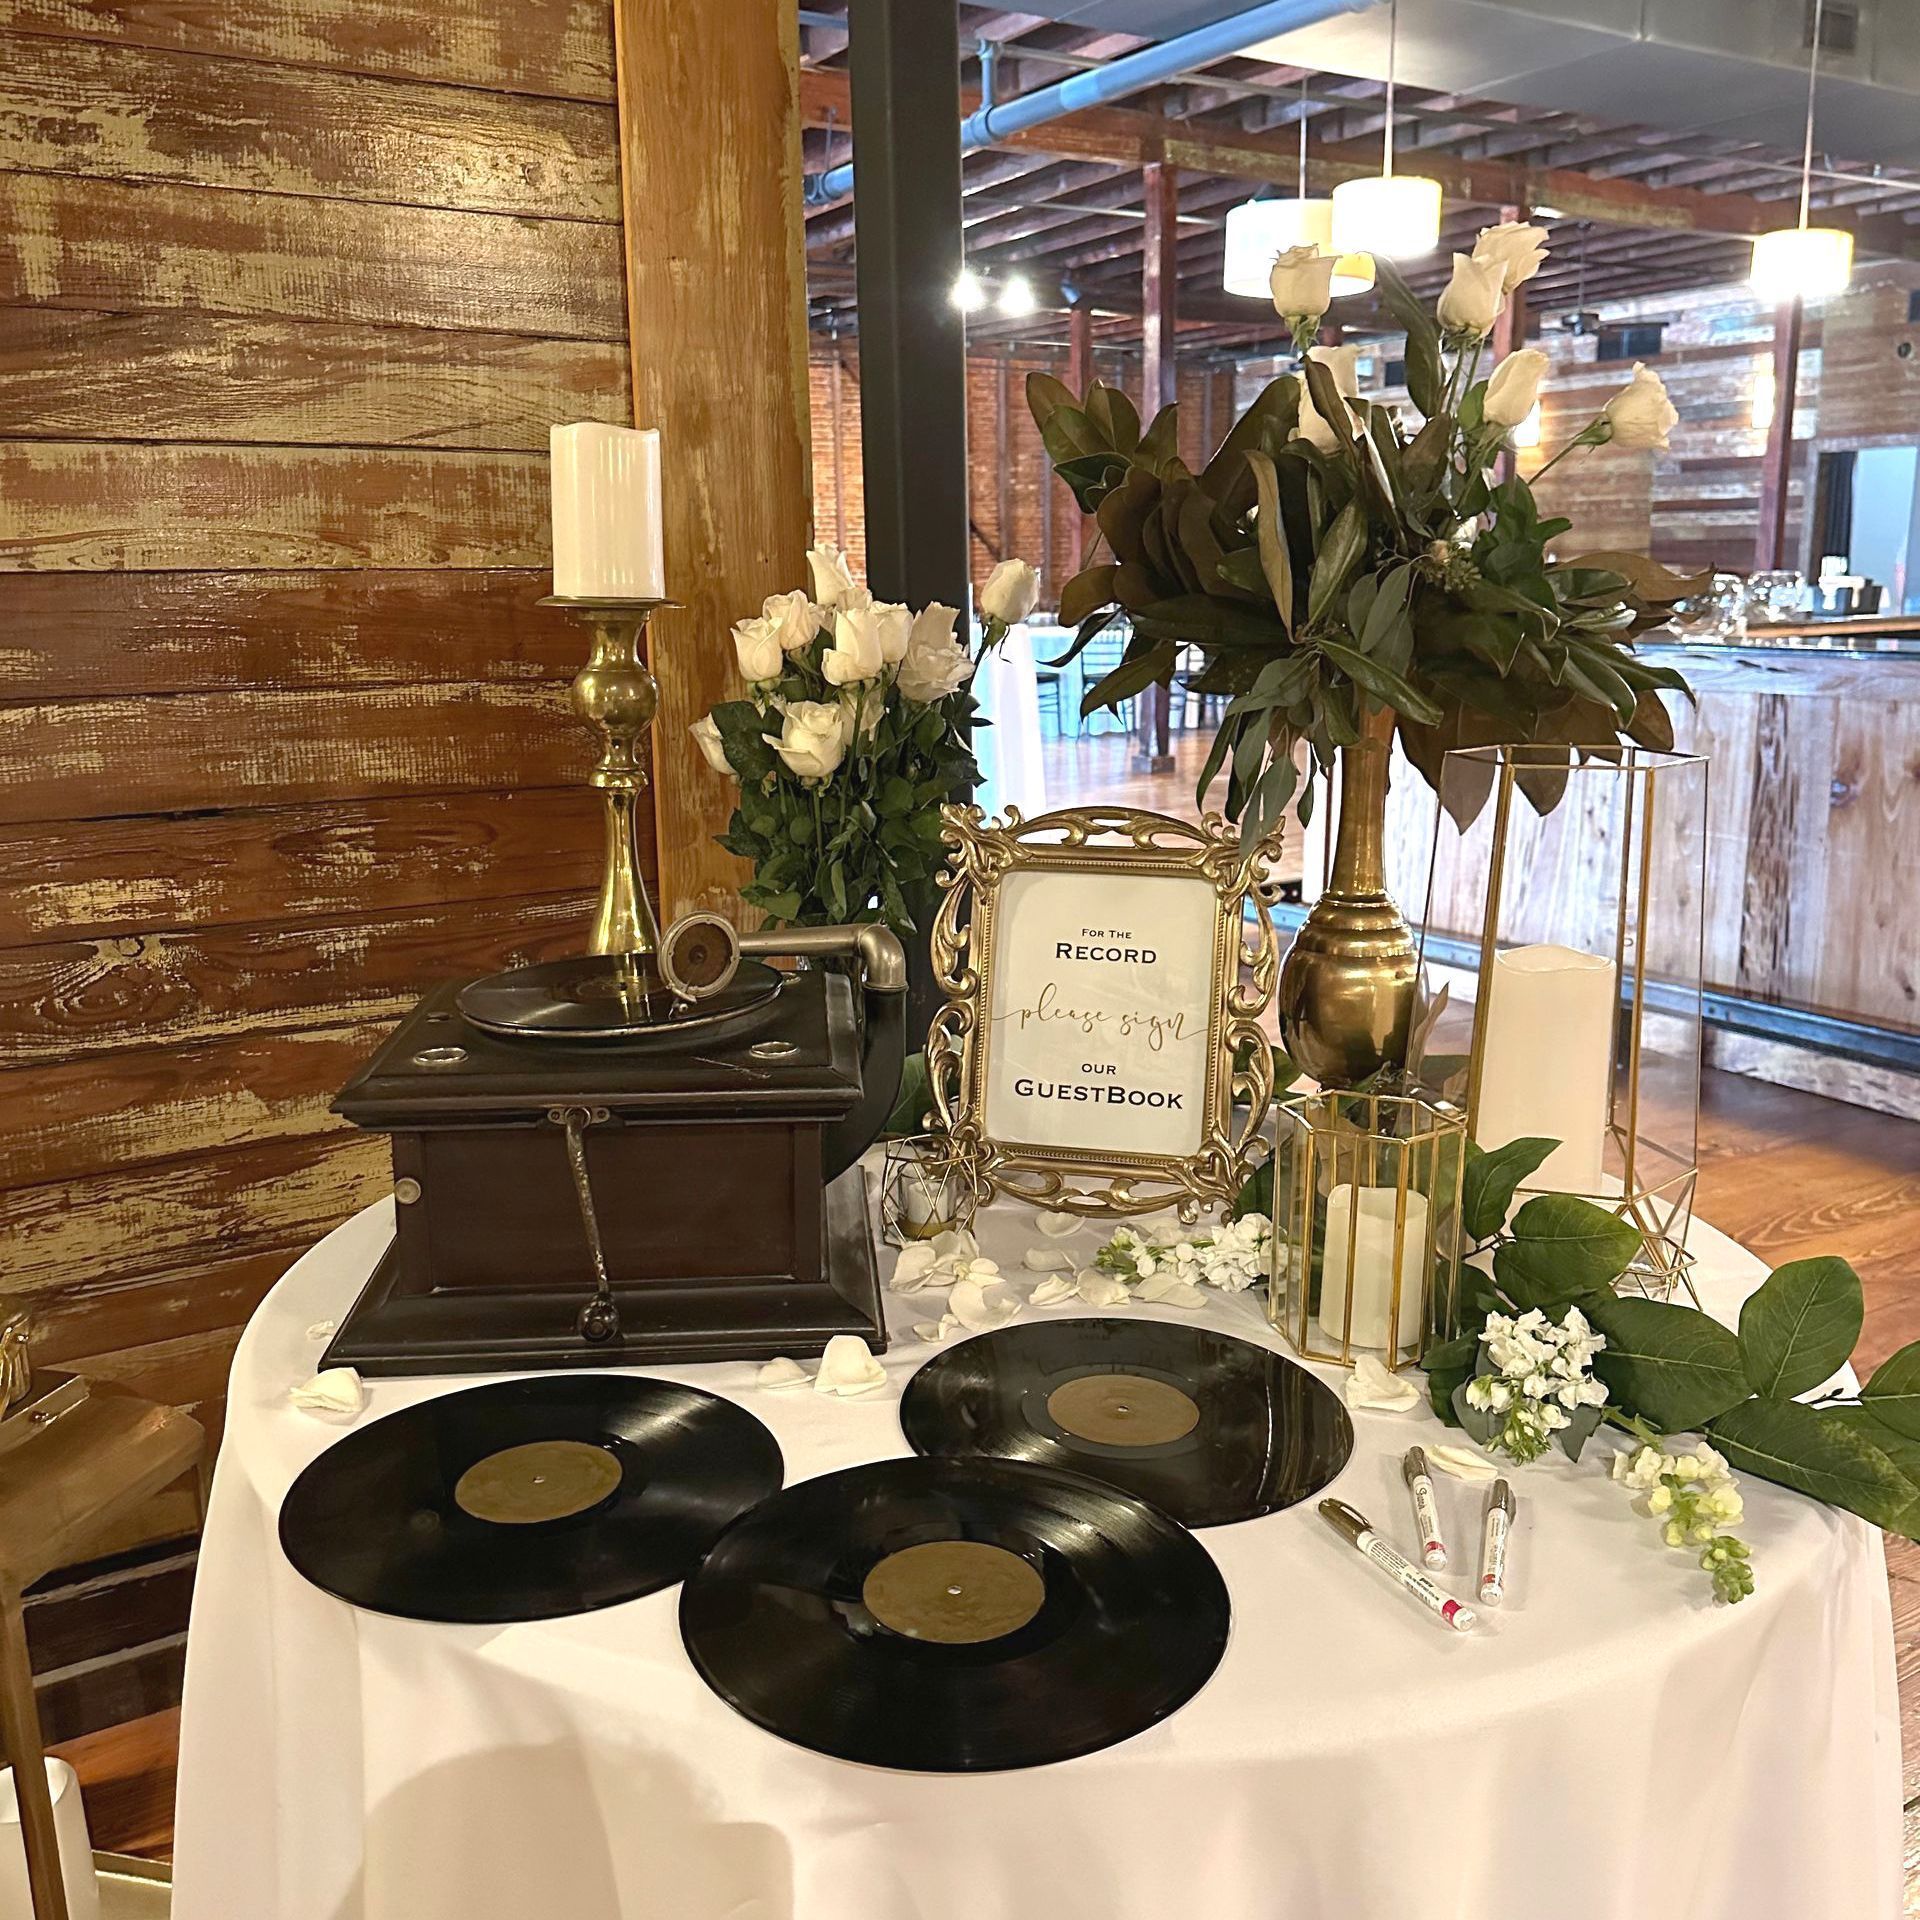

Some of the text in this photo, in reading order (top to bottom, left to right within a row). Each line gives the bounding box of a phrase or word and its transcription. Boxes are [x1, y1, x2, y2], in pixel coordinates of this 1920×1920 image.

[1056, 943, 1156, 964] RECORD
[992, 983, 1208, 1051] please sign
[1082, 1063, 1116, 1075] OUR
